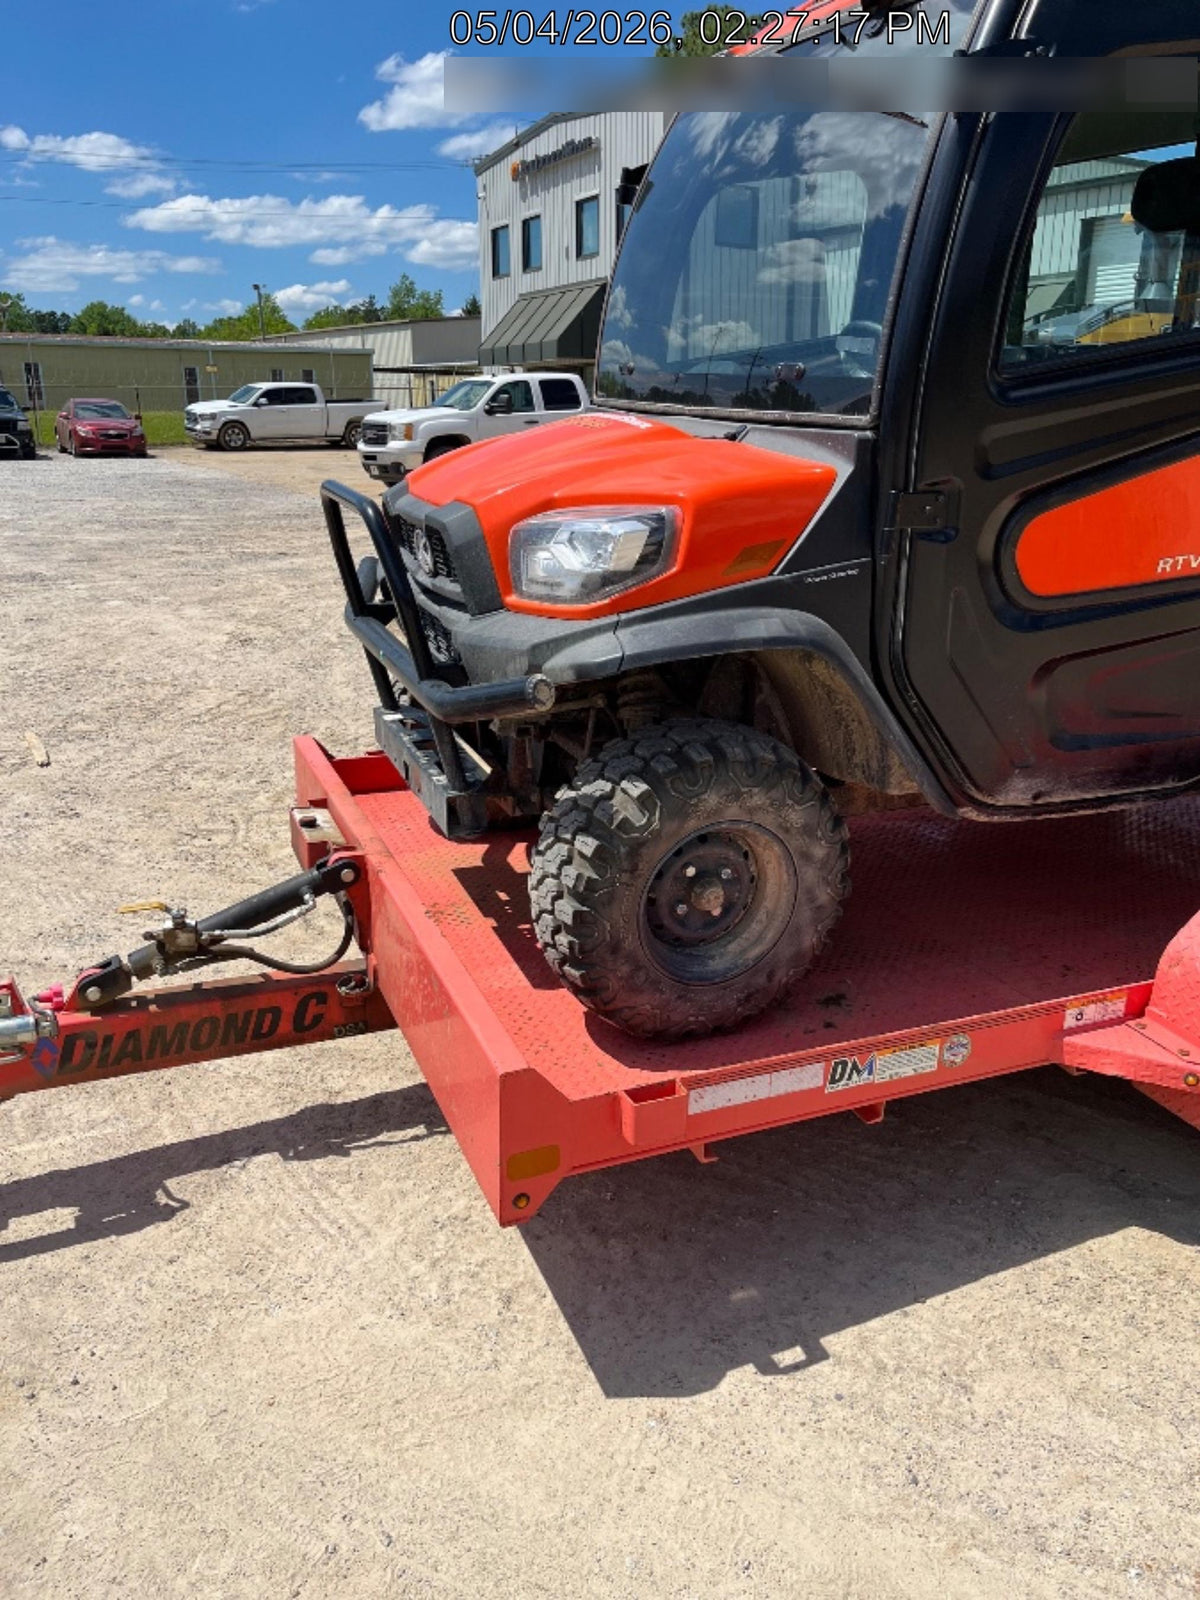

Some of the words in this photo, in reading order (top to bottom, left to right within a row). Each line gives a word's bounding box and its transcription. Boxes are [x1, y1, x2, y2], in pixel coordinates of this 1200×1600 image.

[1157, 554, 1200, 573] RTV
[56, 1006, 282, 1074] DIAMOND
[293, 992, 327, 1033] C
